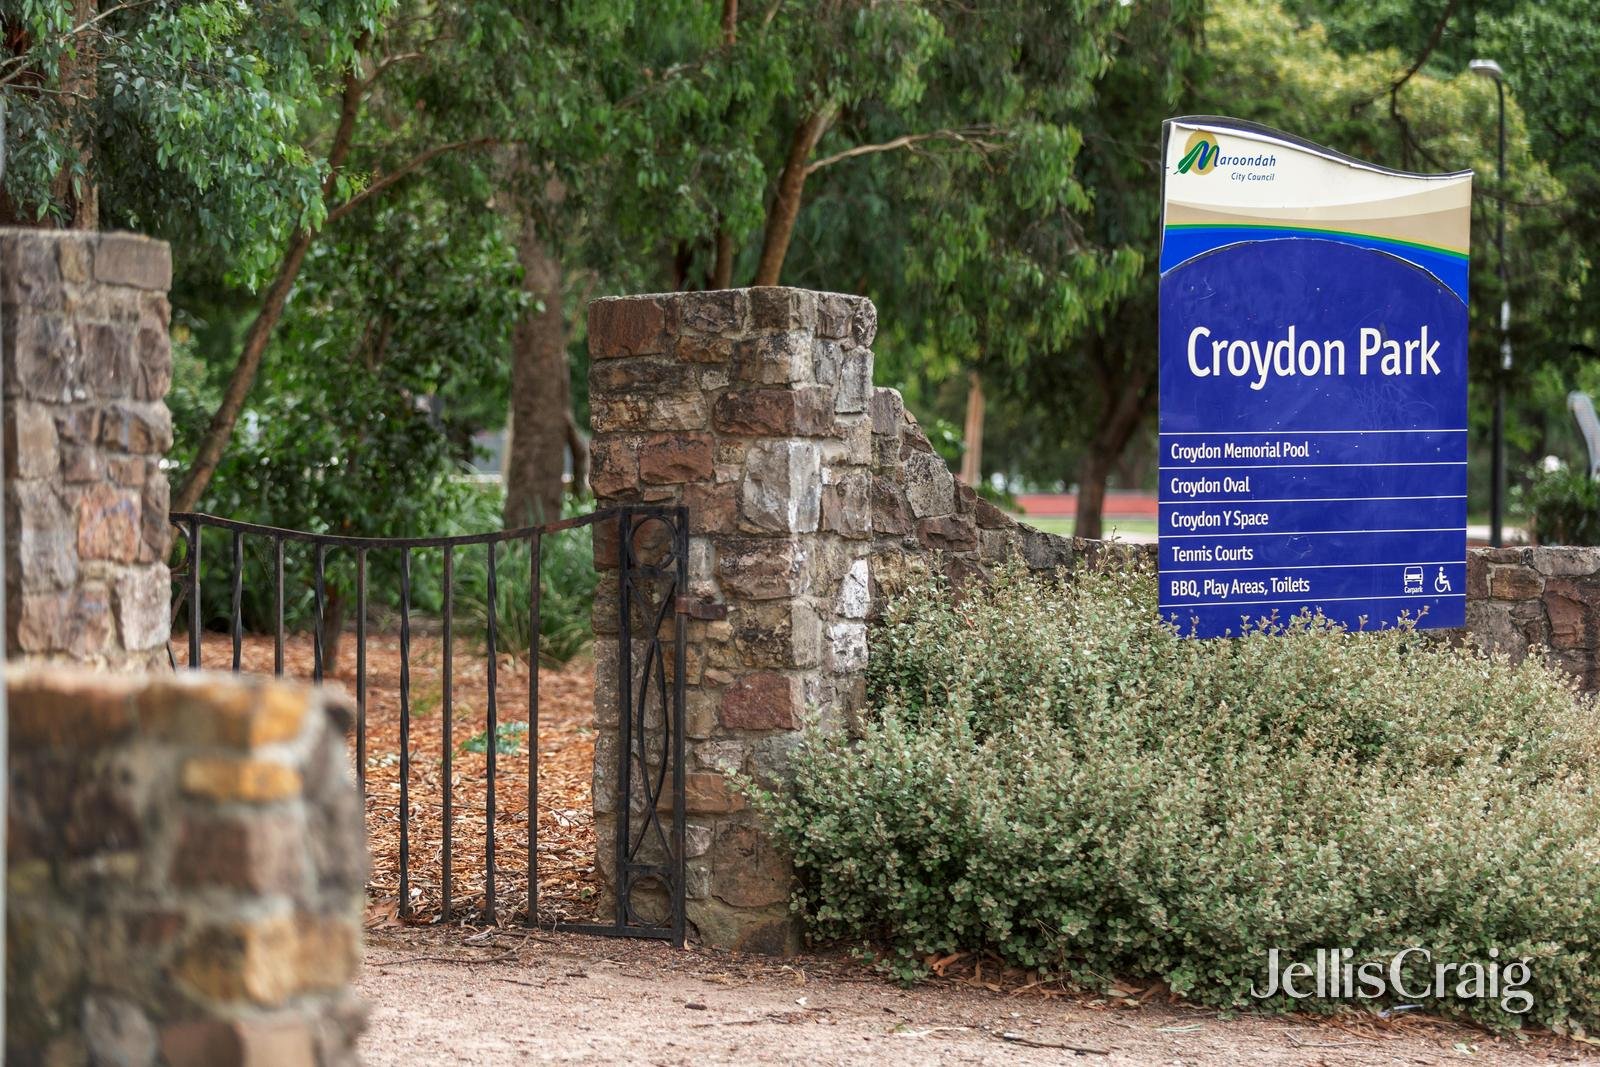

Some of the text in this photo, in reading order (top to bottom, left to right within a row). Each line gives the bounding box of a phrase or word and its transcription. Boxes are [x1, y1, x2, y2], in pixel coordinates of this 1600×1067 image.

[1174, 140, 1276, 175] Maroondah
[1231, 172, 1275, 182] City Council
[1187, 325, 1441, 390] Croydon Park
[1171, 442, 1309, 462] Croydon Memorial Pool
[1171, 476, 1250, 496] Croydon Oval
[1171, 511, 1268, 531] Croydon Y Space
[1172, 546, 1253, 562] Tennis Courts
[1171, 577, 1310, 598] BBQ, Play Areas, Toilets
[1404, 586, 1423, 595] Carpark
